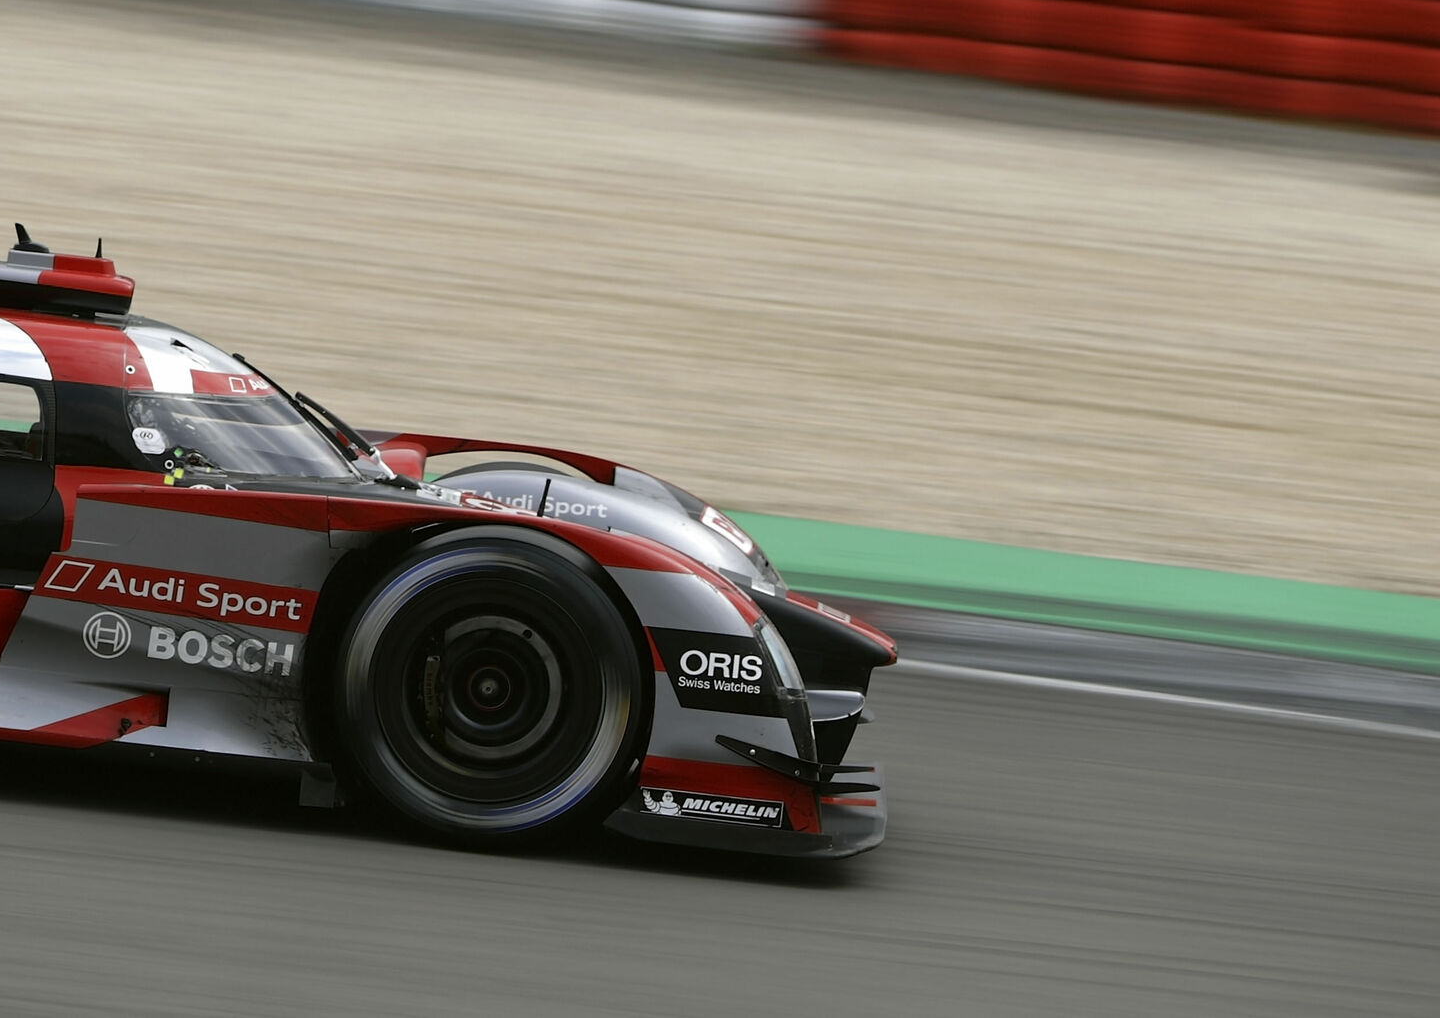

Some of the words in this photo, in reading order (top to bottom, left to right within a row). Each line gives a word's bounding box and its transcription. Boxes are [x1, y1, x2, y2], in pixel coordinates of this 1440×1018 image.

[543, 495, 609, 519] Sport
[97, 568, 185, 603] Audi
[196, 582, 302, 620] Sport
[147, 626, 295, 676] BOSCH
[680, 649, 763, 681] ORIS
[677, 676, 710, 690] Swiss
[713, 680, 761, 694] Watches
[682, 798, 780, 819] MICHELIN
